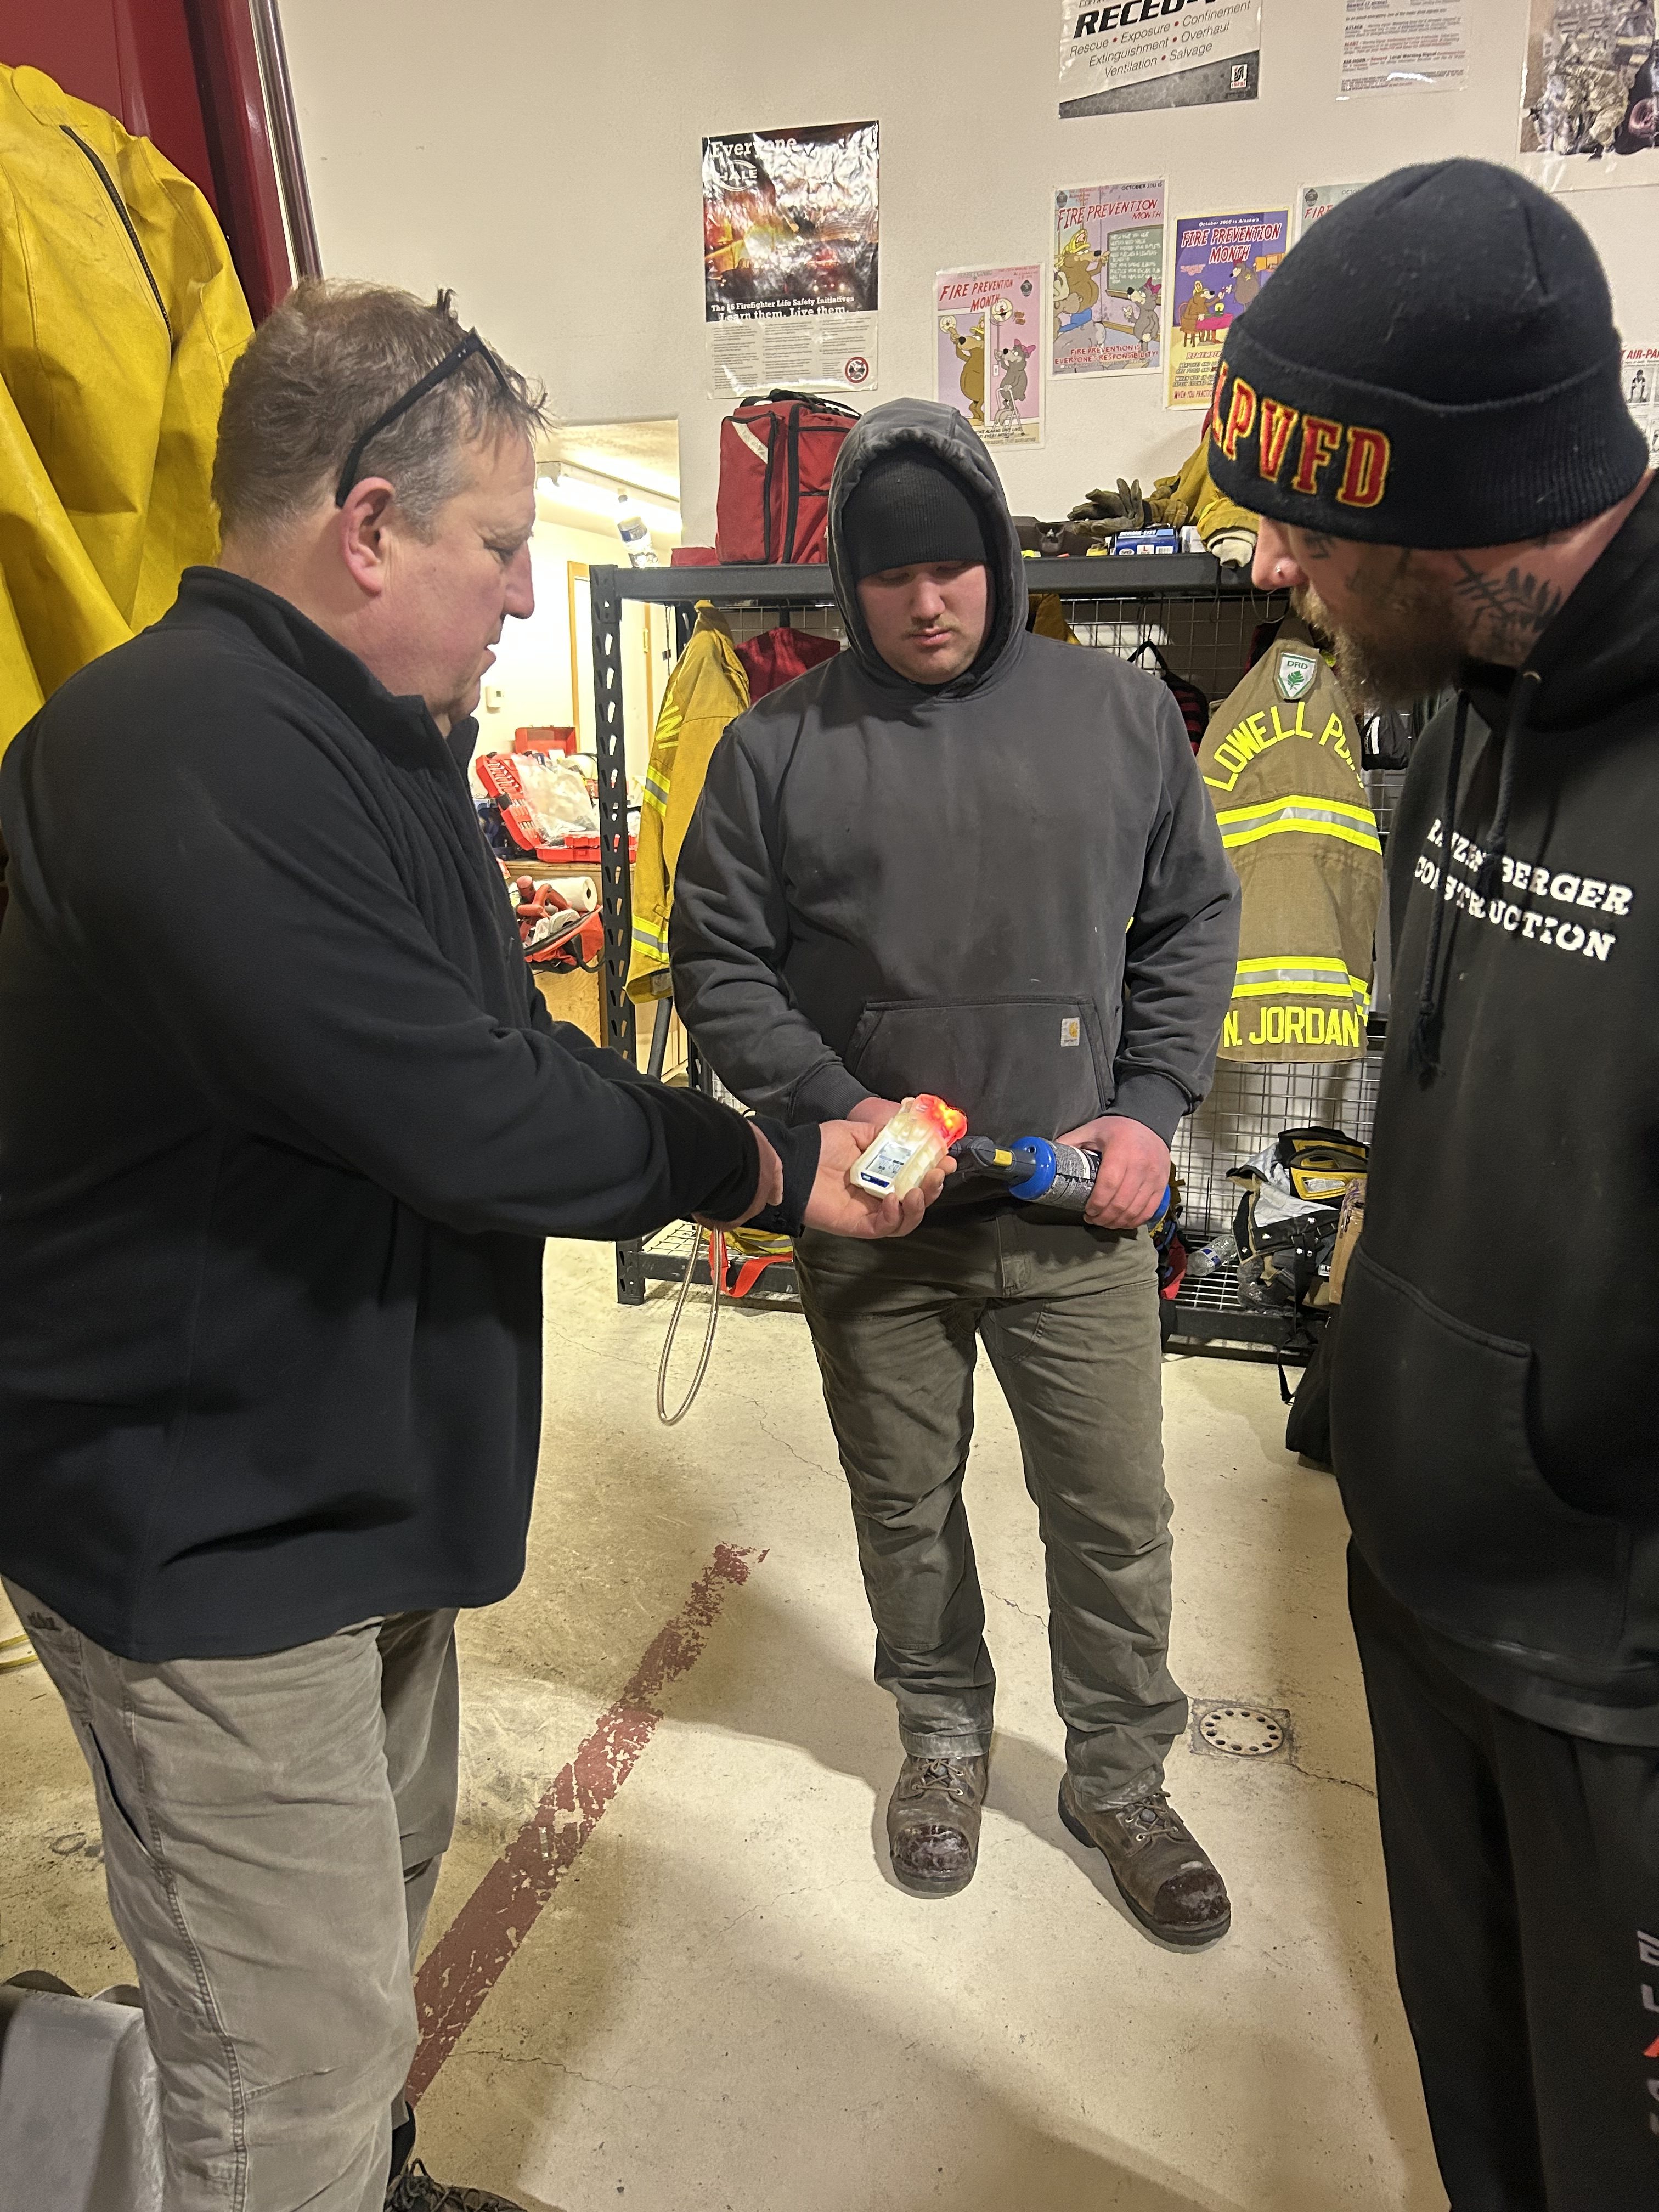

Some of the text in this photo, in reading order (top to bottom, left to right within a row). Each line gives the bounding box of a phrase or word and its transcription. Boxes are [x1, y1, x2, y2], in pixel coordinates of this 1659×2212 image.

[1070, 0, 1251, 57] Rescue Exposure Confinement
[1088, 21, 1230, 67] Extinguishment Overhaul
[1105, 42, 1213, 78] Ventilation Salvage
[1057, 199, 1158, 231] FIRE PREVENTION
[1132, 210, 1162, 219] MONTH
[1181, 222, 1283, 248] FIRE PREVENTION
[1209, 244, 1251, 265] MONTH
[939, 279, 1013, 301] FIRE PREVENTION
[720, 305, 849, 320] Learn them. Live them.
[736, 302, 775, 310] Firefighter
[793, 298, 815, 307] Safety
[816, 296, 854, 304] Initiatives
[970, 294, 1000, 313] MONTH
[1088, 345, 1133, 354] PREVENTION
[1099, 350, 1158, 361] RESPONSIBILITY!
[1627, 349, 1659, 359] AIR-PA
[1212, 361, 1391, 507] LPVFD
[1286, 660, 1308, 670] DRD
[1202, 701, 1313, 792] LOWELL
[1223, 1006, 1359, 1048] N. JORDAN
